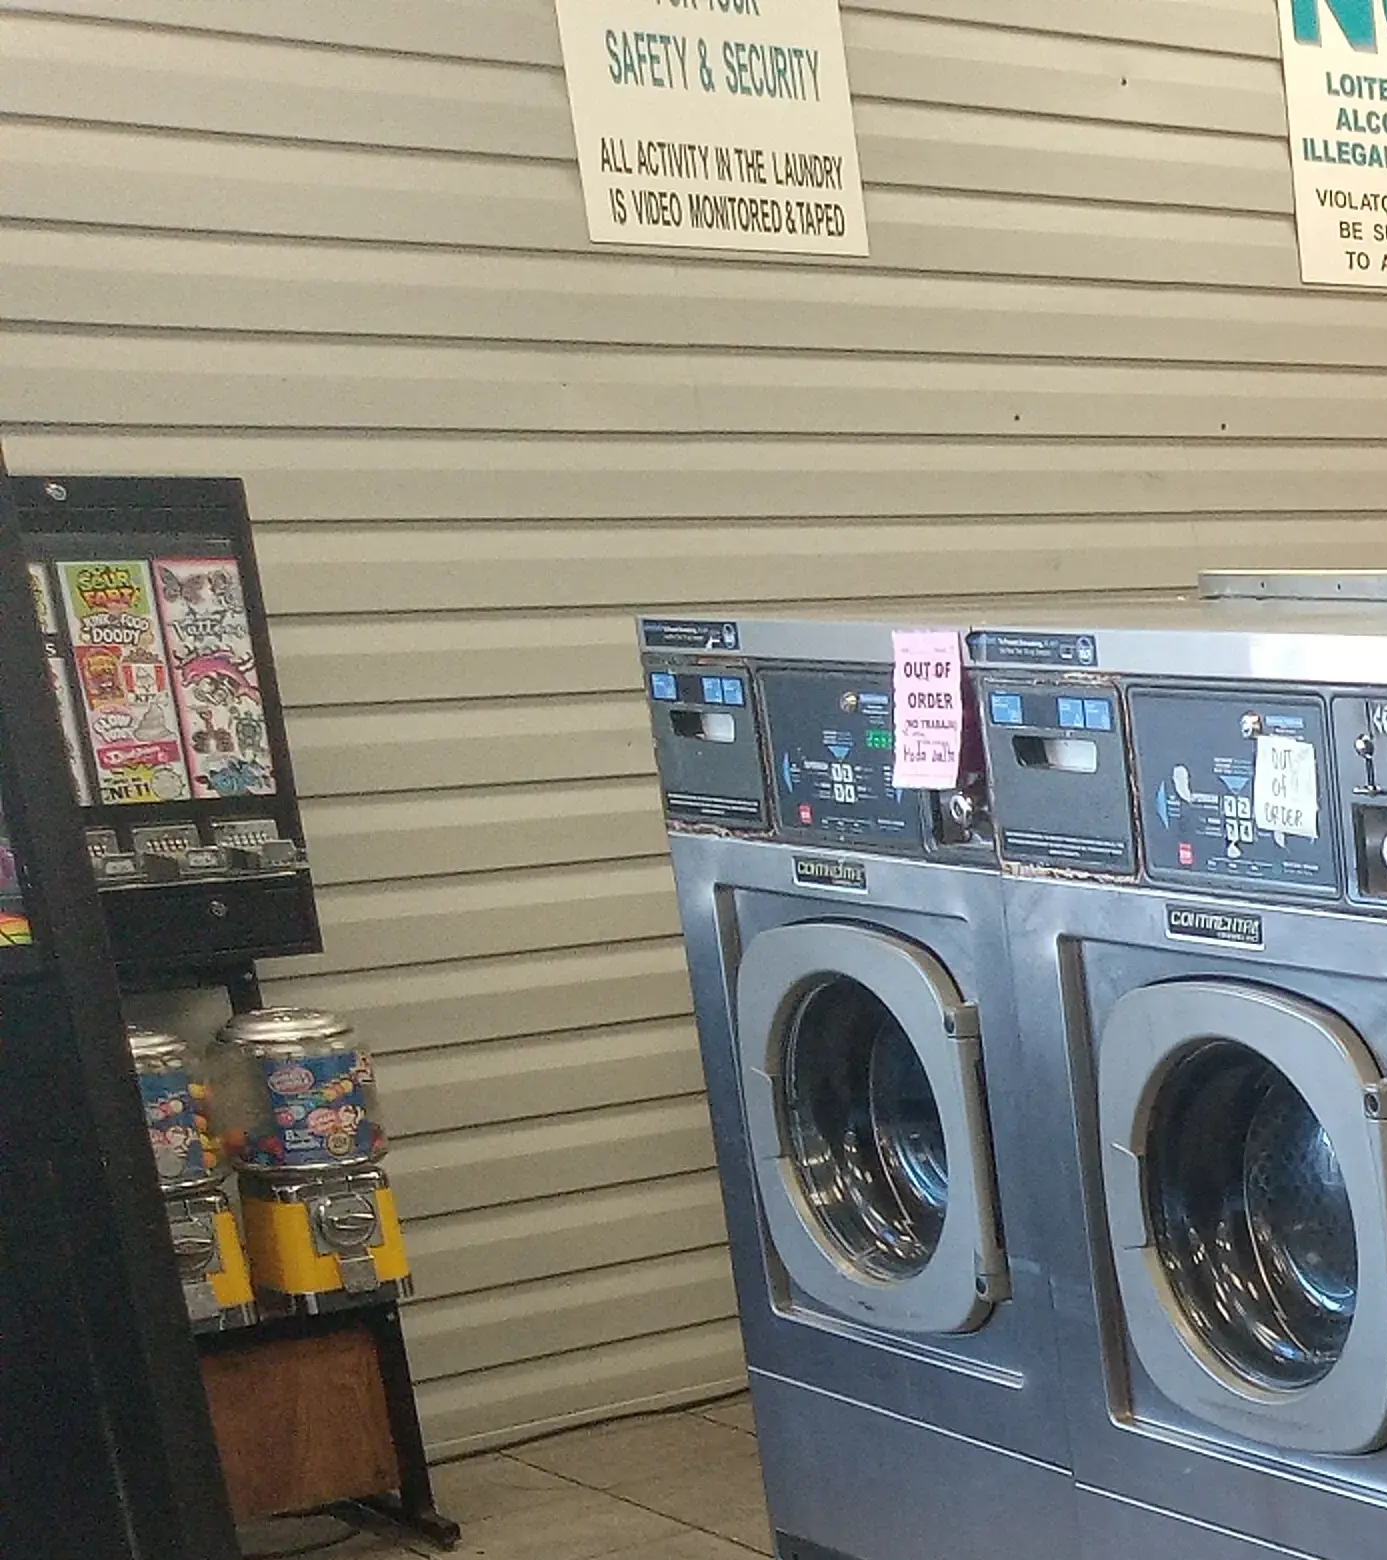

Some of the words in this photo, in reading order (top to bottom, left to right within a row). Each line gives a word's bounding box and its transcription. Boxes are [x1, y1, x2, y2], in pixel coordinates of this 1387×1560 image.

[605, 29, 690, 88] SAFETY
[699, 38, 715, 93] &
[723, 41, 820, 101] SECURITY
[601, 137, 632, 175] ALL
[637, 140, 709, 180] ACTIVITY
[716, 145, 733, 180] IN
[735, 147, 767, 185] THE
[772, 151, 843, 190] LAUNDRY
[609, 188, 627, 225] IS
[631, 190, 683, 227] VIDEO
[690, 196, 782, 234] MONITORED
[1339, 221, 1363, 240] BE
[1345, 251, 1370, 270] TO
[92, 629, 141, 645] DOODY
[904, 662, 930, 678] OUT
[935, 662, 951, 678] OF
[908, 692, 953, 709] ORDER
